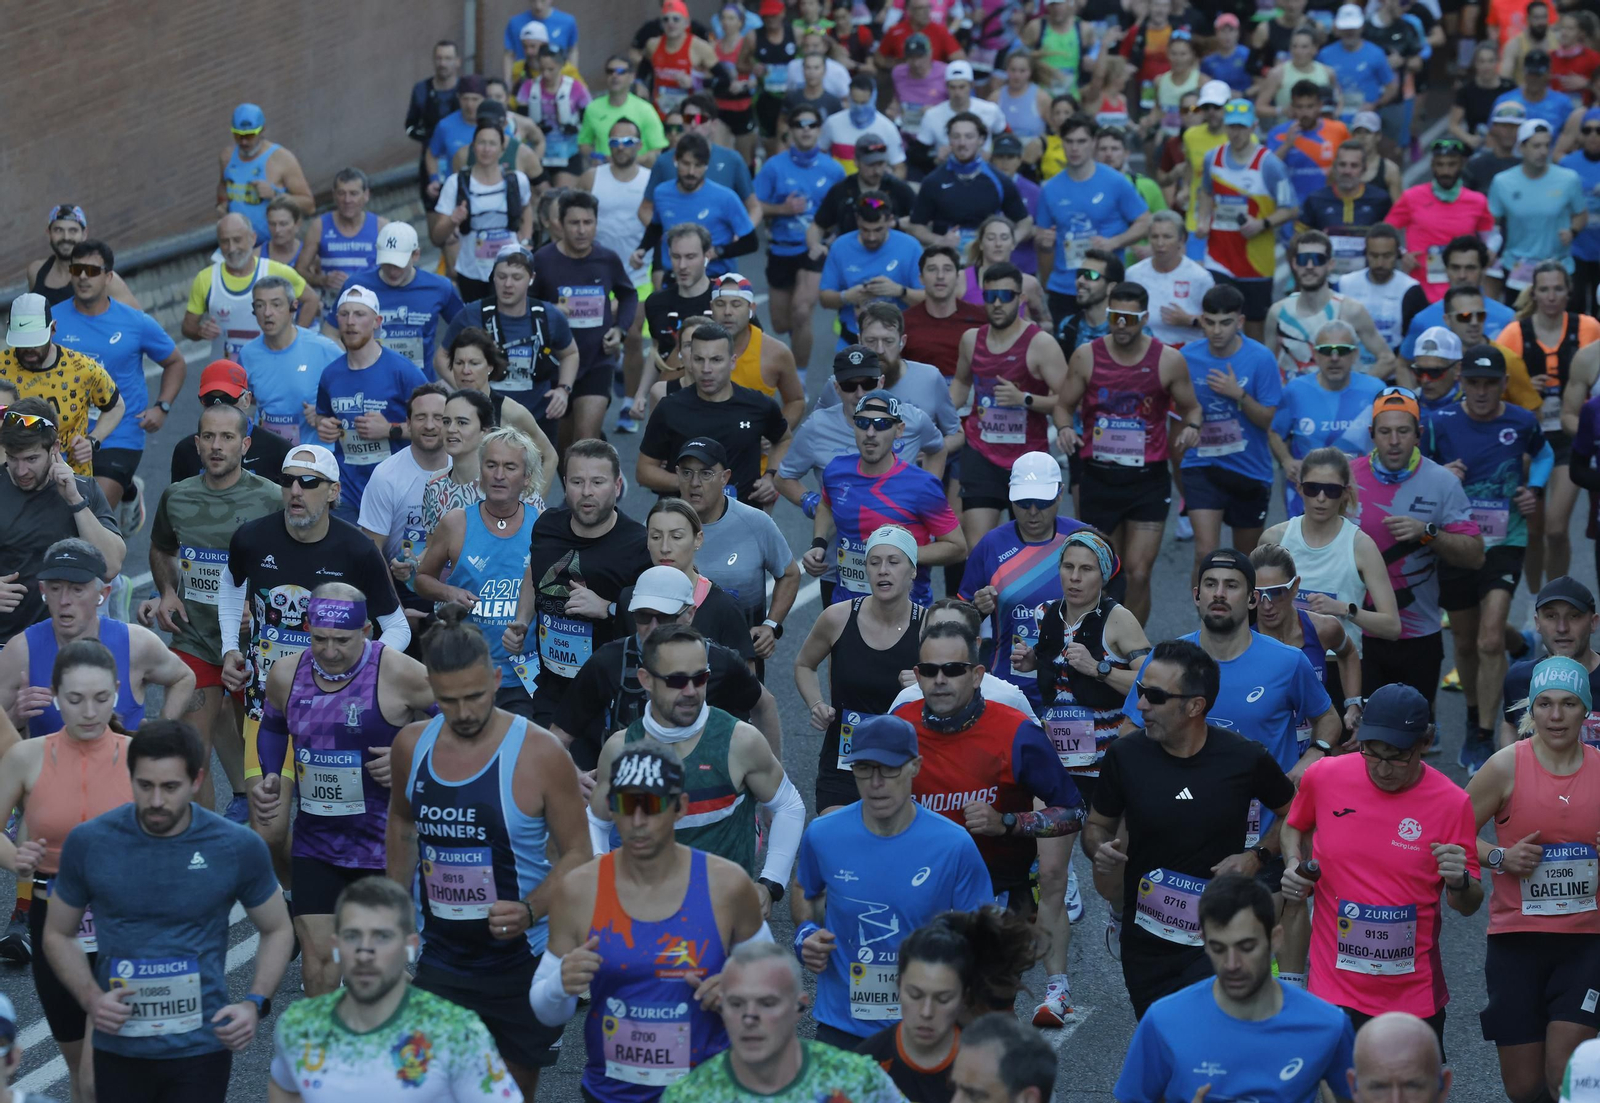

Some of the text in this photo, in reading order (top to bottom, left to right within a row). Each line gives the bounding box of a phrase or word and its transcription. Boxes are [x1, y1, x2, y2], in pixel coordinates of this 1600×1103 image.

[389, 330, 417, 338] ZURICH
[346, 442, 381, 454] FOSTER
[998, 546, 1019, 563] Joma
[198, 567, 220, 577] 11645
[837, 565, 865, 581] PEDRO
[317, 610, 351, 620] GOYA
[553, 620, 586, 634] ZURICH
[553, 637, 570, 649] 6546
[549, 646, 578, 665] RAMA
[1053, 727, 1071, 737] 9750
[313, 753, 353, 765] ZURICH
[313, 772, 339, 784] 11056
[311, 784, 344, 801] JOSÉ
[419, 805, 476, 823] POOLE
[438, 852, 483, 863] ZURICH
[1545, 846, 1589, 859] ZURICH
[442, 872, 465, 884] 8918
[1544, 867, 1574, 879] 12506
[430, 883, 487, 902] THOMAS
[1529, 880, 1590, 899] GAELINE
[1162, 894, 1188, 910] 8716
[1364, 908, 1409, 920] ZURICH
[1365, 929, 1390, 941] 9135
[1337, 941, 1415, 960] DIEGO-ALVARO
[138, 961, 188, 975] ZURICH
[850, 991, 889, 1004] JAVIER
[126, 997, 197, 1018] ATTHIEU
[629, 1006, 680, 1019] ZURICH
[630, 1030, 656, 1043] 8700
[615, 1044, 674, 1065] RAFAEL
